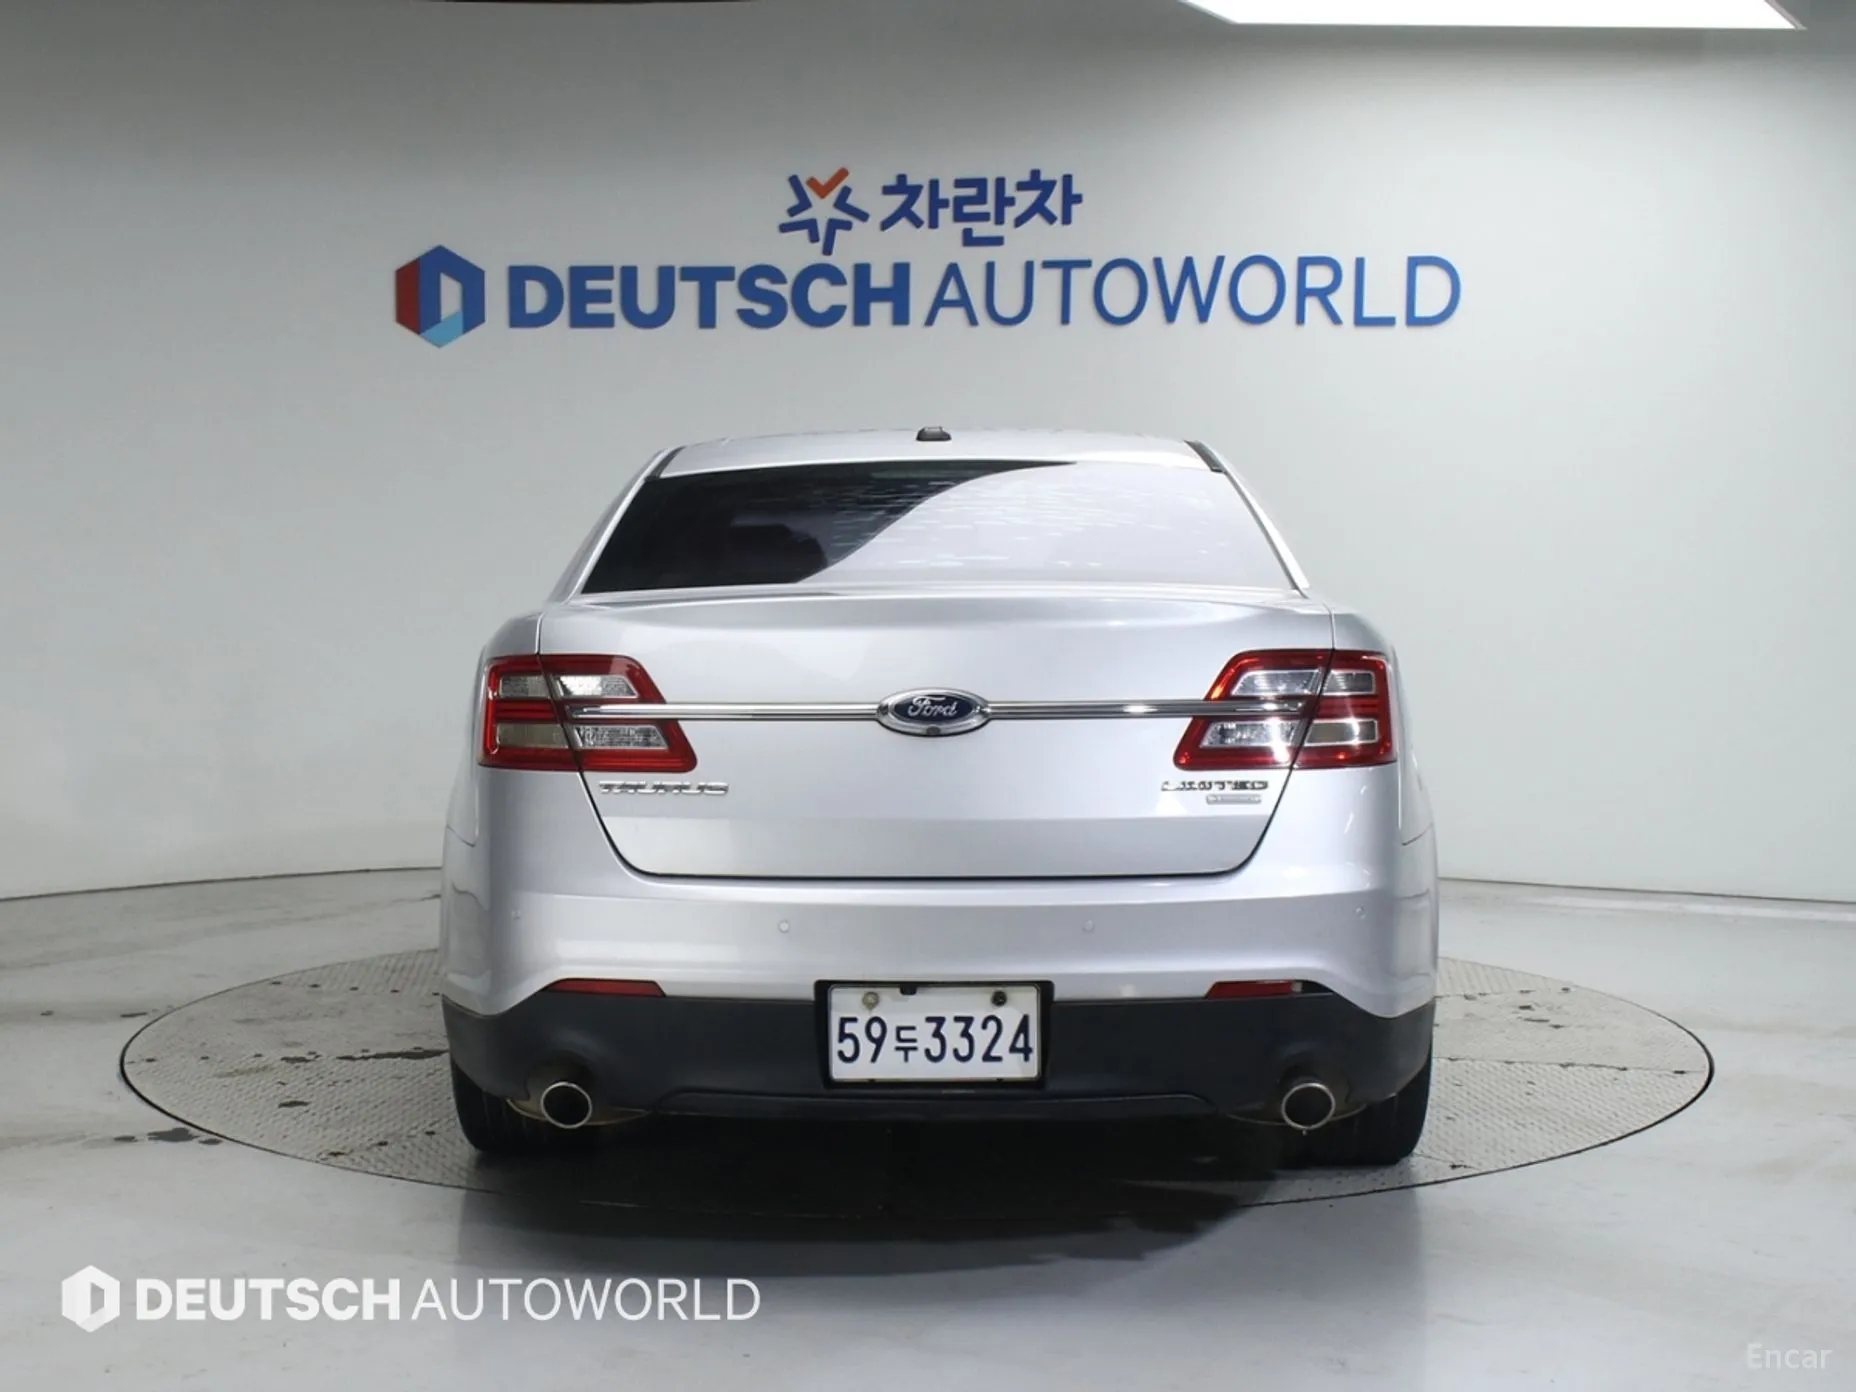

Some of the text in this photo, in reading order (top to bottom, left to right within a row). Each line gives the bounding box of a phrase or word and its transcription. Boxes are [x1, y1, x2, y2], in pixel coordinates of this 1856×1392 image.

[881, 168, 1083, 246] 차란차
[507, 254, 1463, 330] DEUTSCH AUTOWORLD
[907, 695, 958, 718] Ford
[598, 780, 729, 796] TAURUS
[836, 1014, 1034, 1064] 59두3324
